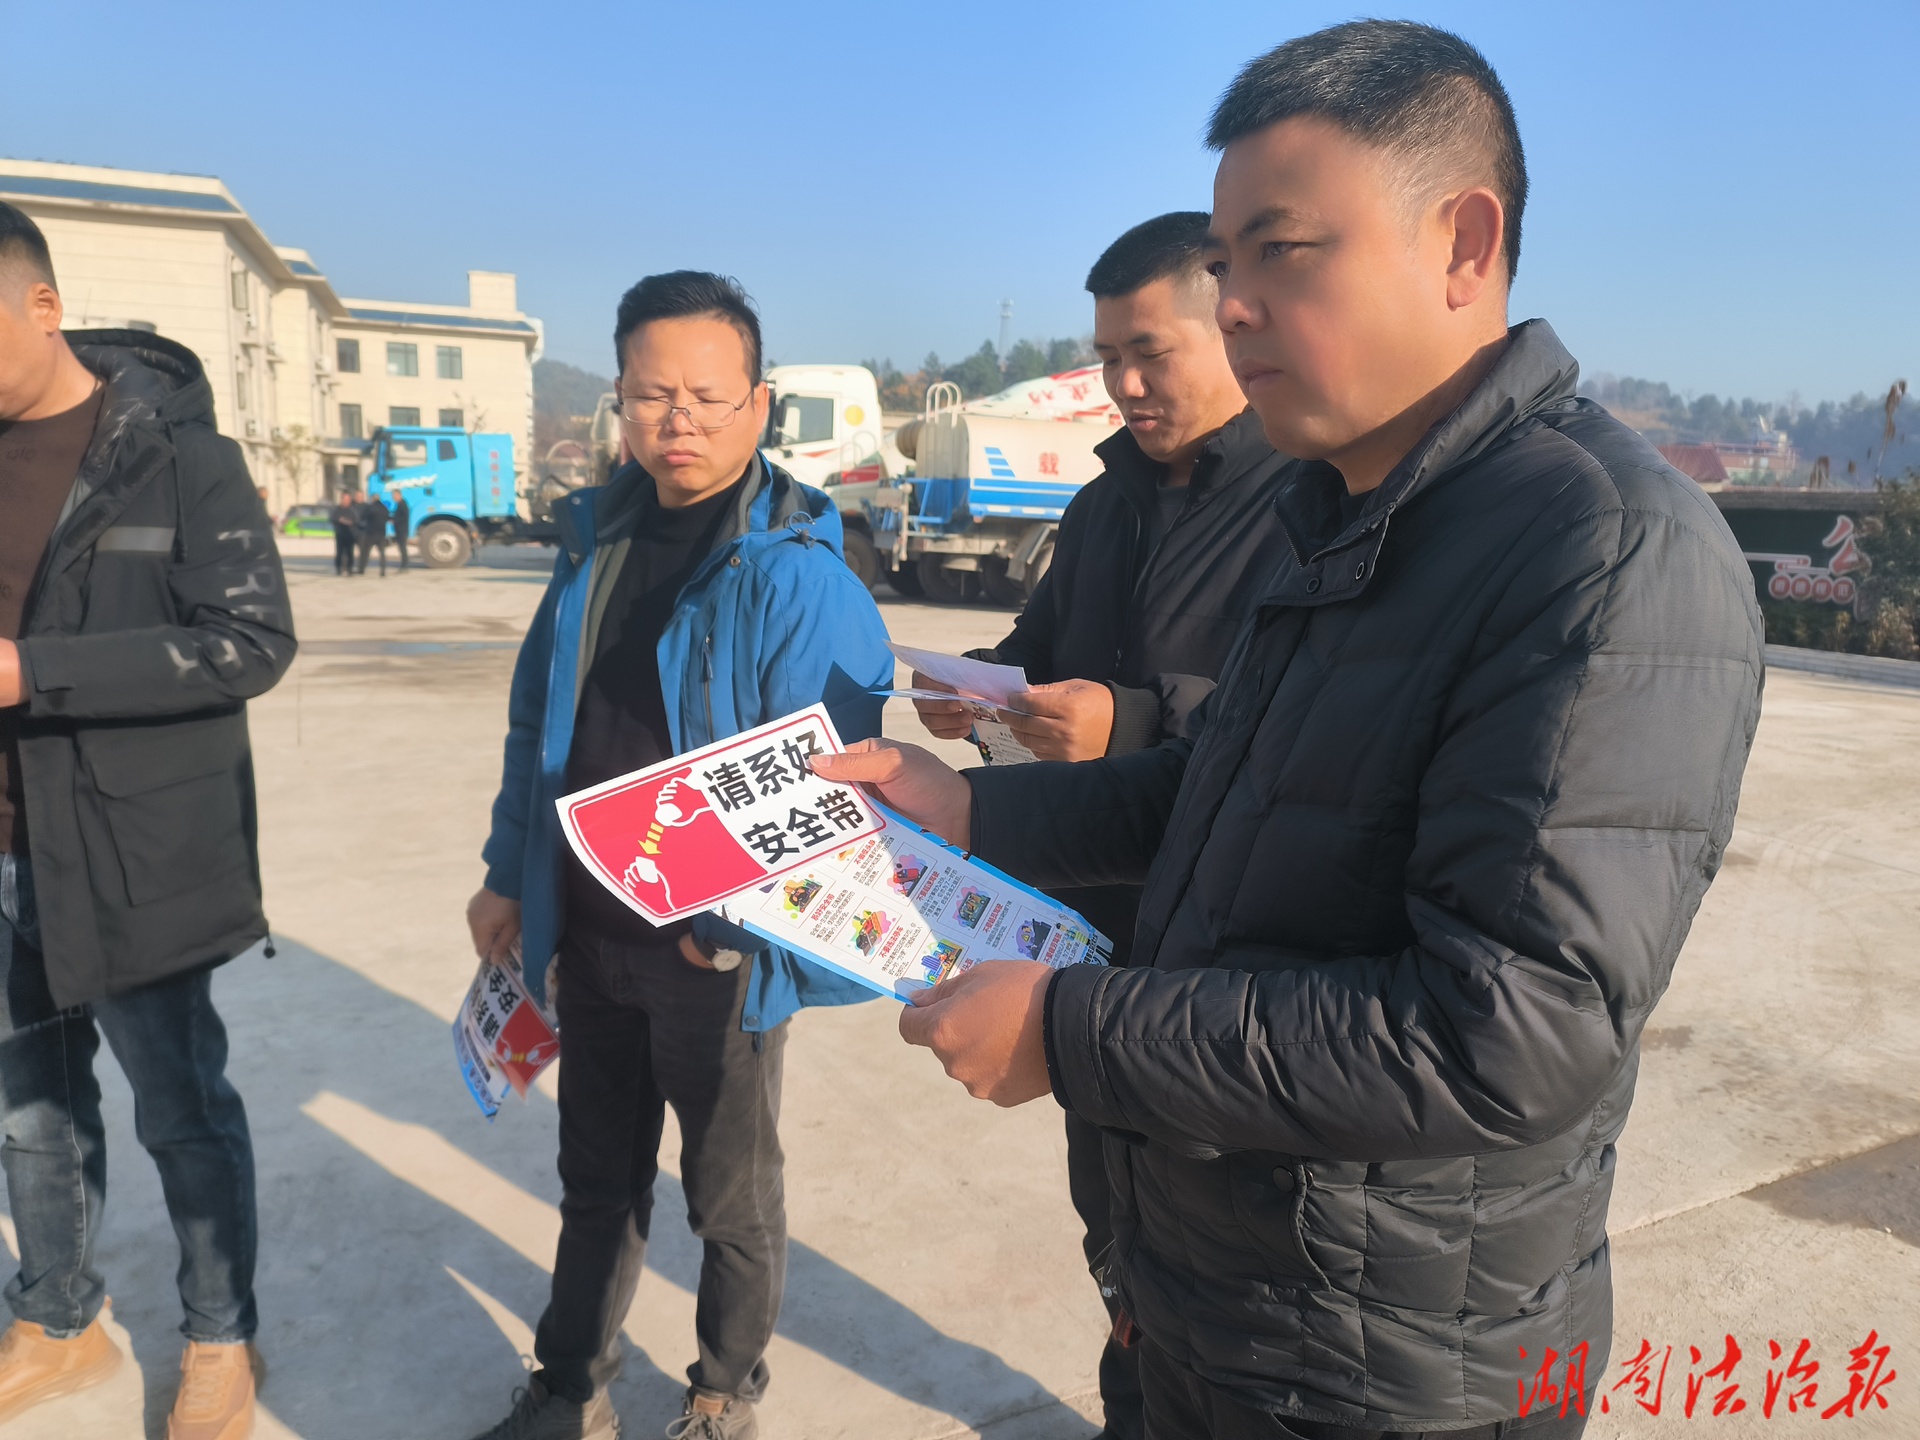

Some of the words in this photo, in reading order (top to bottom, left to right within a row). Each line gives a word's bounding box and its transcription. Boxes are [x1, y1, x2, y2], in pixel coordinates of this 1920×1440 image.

[702, 730, 825, 813] 请系好
[741, 788, 865, 864] 安全带
[915, 870, 940, 901] 不要超速驾驶
[810, 893, 835, 921] 系好安全带
[878, 925, 904, 958] 不要违法停车
